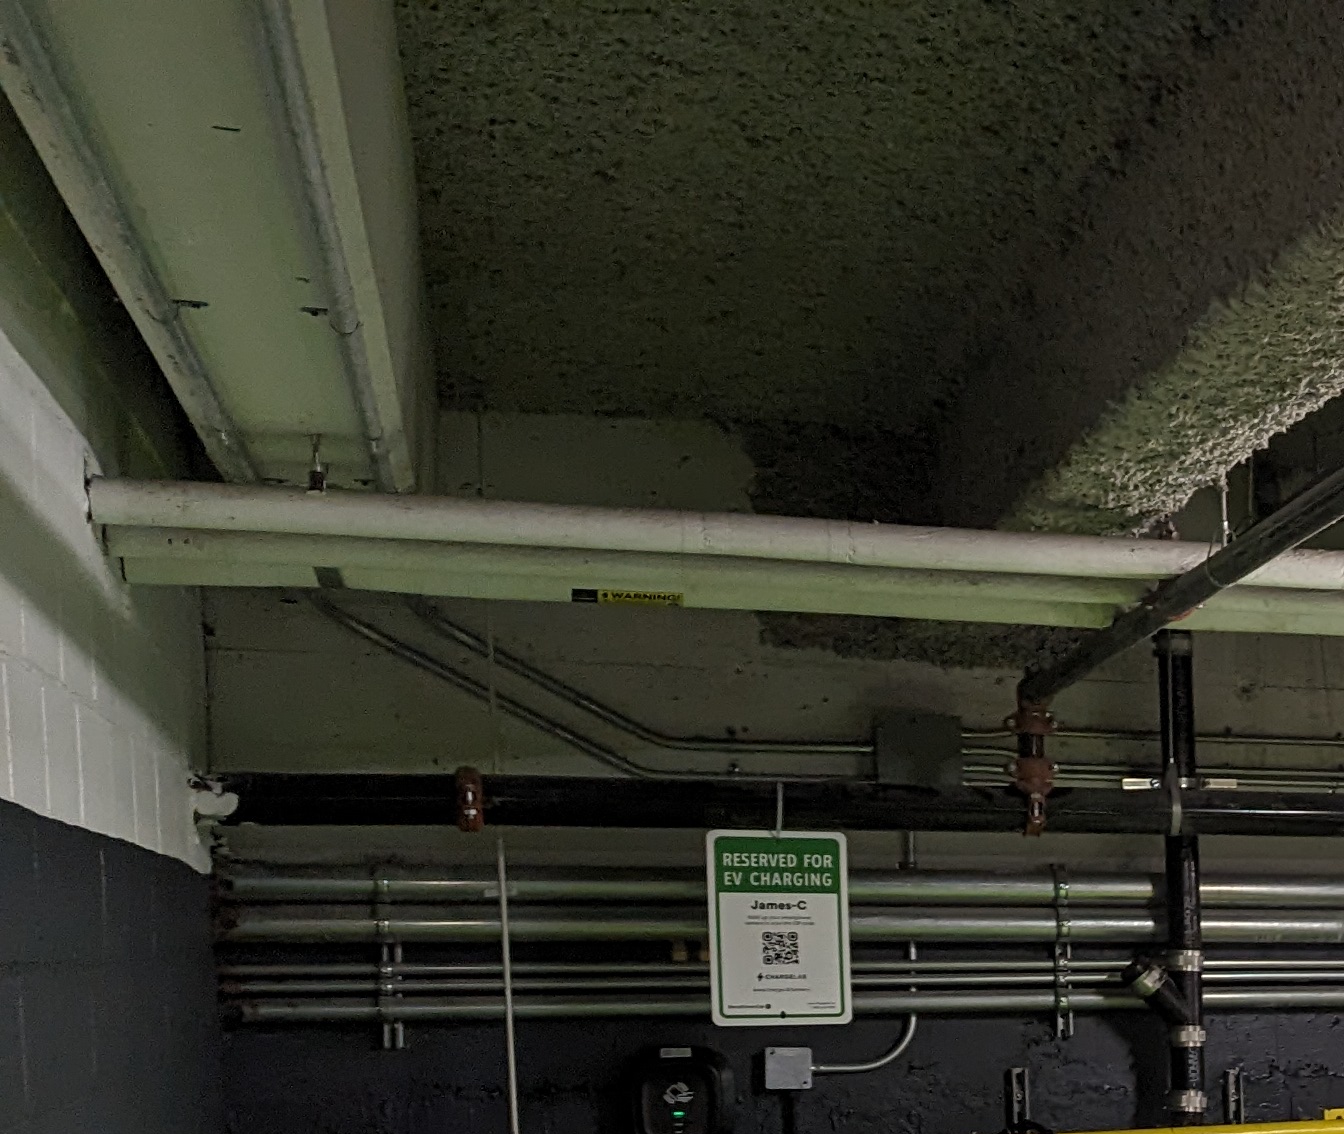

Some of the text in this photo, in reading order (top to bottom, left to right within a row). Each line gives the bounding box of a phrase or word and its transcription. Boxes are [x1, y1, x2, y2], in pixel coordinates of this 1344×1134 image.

[722, 852, 834, 868] RESERVED FOR
[723, 871, 833, 887] EV CHARGING
[750, 900, 808, 911] James-C
